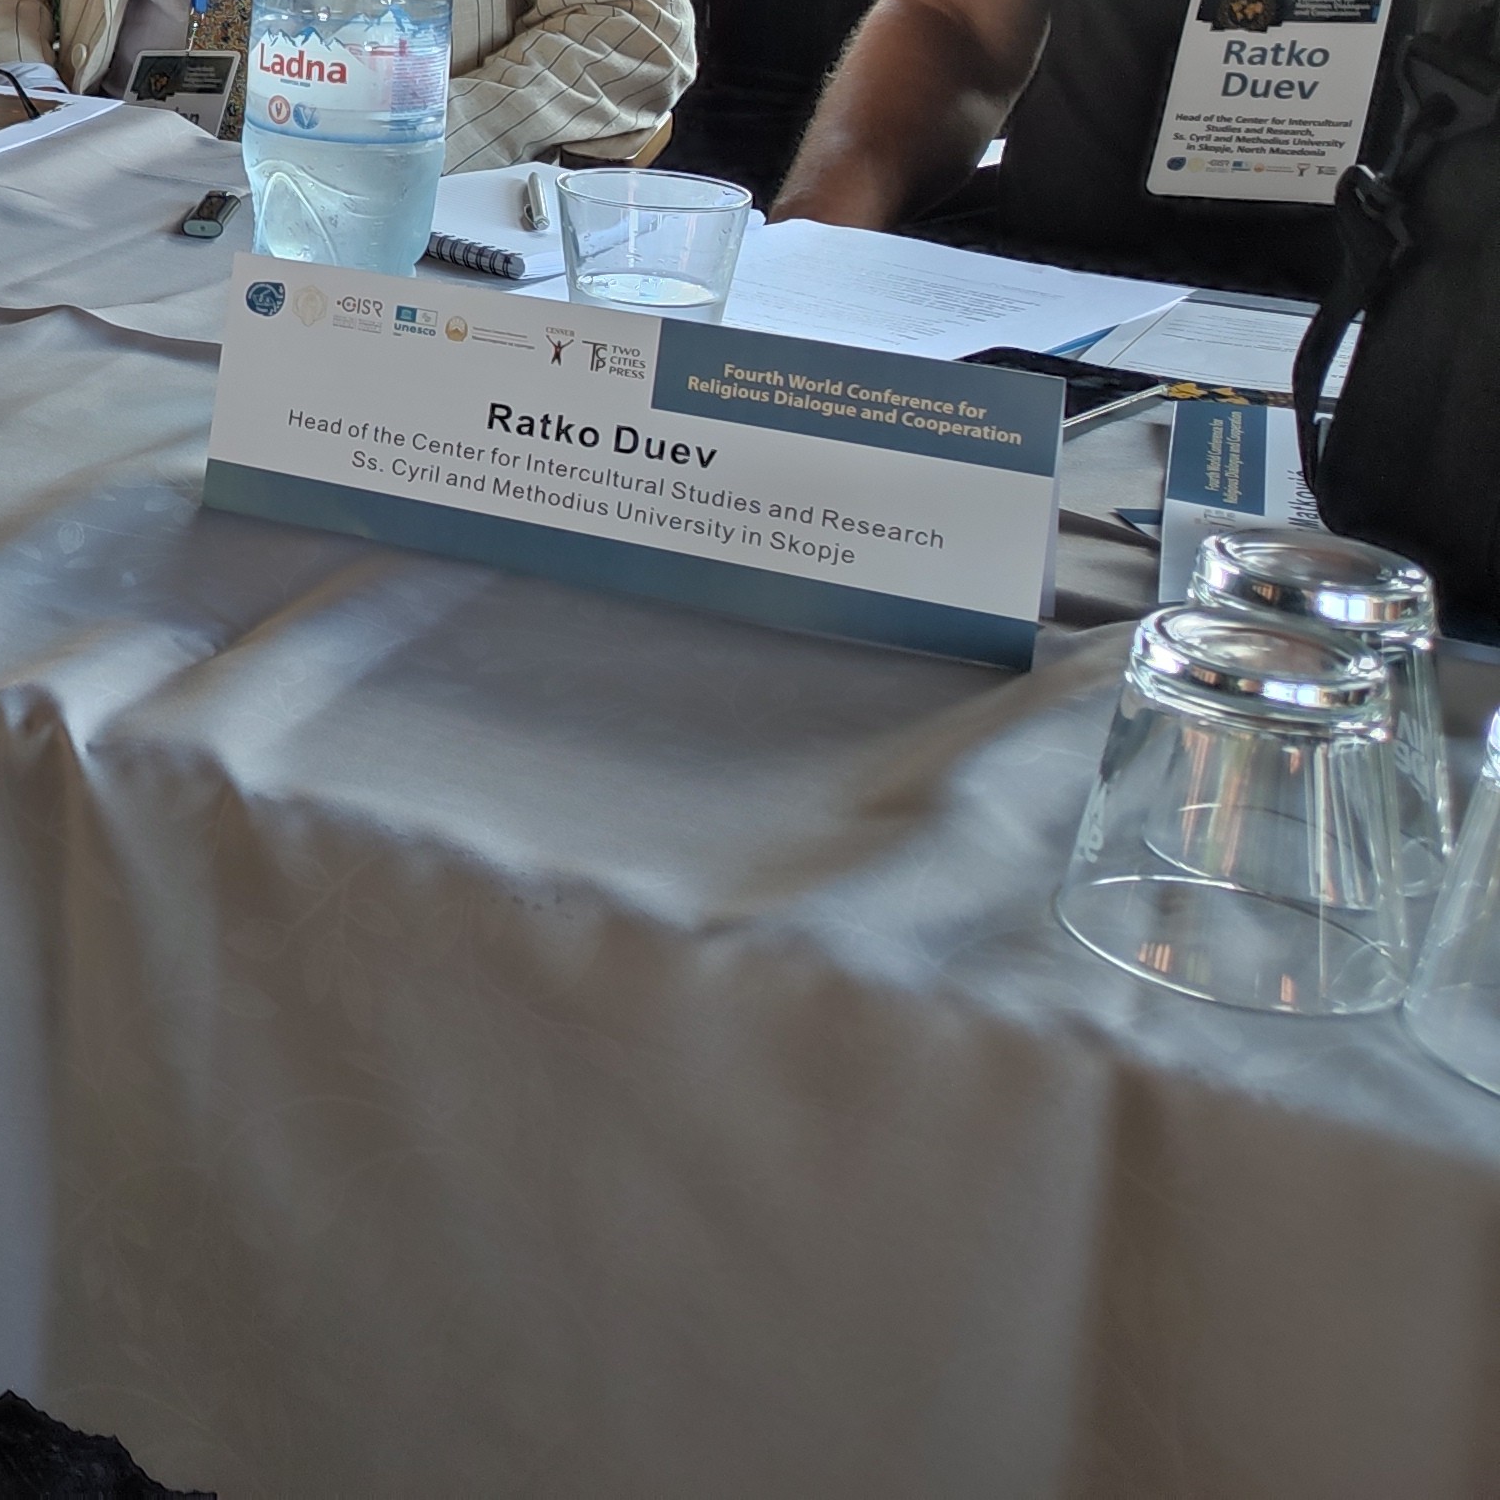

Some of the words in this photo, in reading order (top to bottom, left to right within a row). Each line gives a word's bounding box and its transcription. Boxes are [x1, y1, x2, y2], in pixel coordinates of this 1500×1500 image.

[259, 43, 348, 85] Ladna
[1222, 39, 1330, 68] Ratko
[1220, 71, 1320, 100] Duev
[1175, 113, 1201, 122] Head
[1202, 114, 1215, 122] of
[1216, 115, 1233, 123] the
[1235, 116, 1270, 125] Center
[1271, 117, 1285, 126] for
[1288, 118, 1352, 128] Intercultural
[1205, 124, 1242, 134] Studies
[1244, 126, 1264, 135] and
[1186, 143, 1196, 151] in
[1236, 145, 1267, 155] North
[1269, 147, 1326, 157] Macedonia
[1189, 133, 1212, 143] Cyril
[1213, 134, 1233, 143] and
[1235, 135, 1291, 146] Methodius
[1293, 138, 1346, 149] University
[393, 322, 437, 337] unesco
[609, 355, 647, 369] CITIES
[611, 345, 641, 357] TWO
[608, 366, 645, 380] PRESS
[724, 363, 784, 387] Fourth
[788, 373, 843, 397] World
[846, 383, 954, 415] Conference
[957, 400, 988, 420] for
[687, 375, 770, 402] Religious
[773, 390, 857, 419] Dialogue
[860, 403, 898, 424] and
[901, 411, 1023, 446] Cooperation
[486, 402, 601, 450] Ratko
[613, 424, 718, 469] Duev
[288, 409, 343, 435] Head
[347, 422, 370, 438] of
[372, 426, 406, 447] the
[411, 433, 486, 462] Center
[490, 446, 521, 469] for
[526, 453, 665, 497] Intercultural
[670, 481, 761, 514] Studies
[768, 501, 814, 525] and
[821, 508, 945, 549] Research
[351, 450, 385, 473] Ss.
[391, 458, 440, 483] Cyril
[446, 470, 486, 492] and
[492, 477, 609, 516] Methodius
[616, 500, 736, 544] University
[741, 525, 762, 546] in
[769, 530, 856, 566] Skopje
